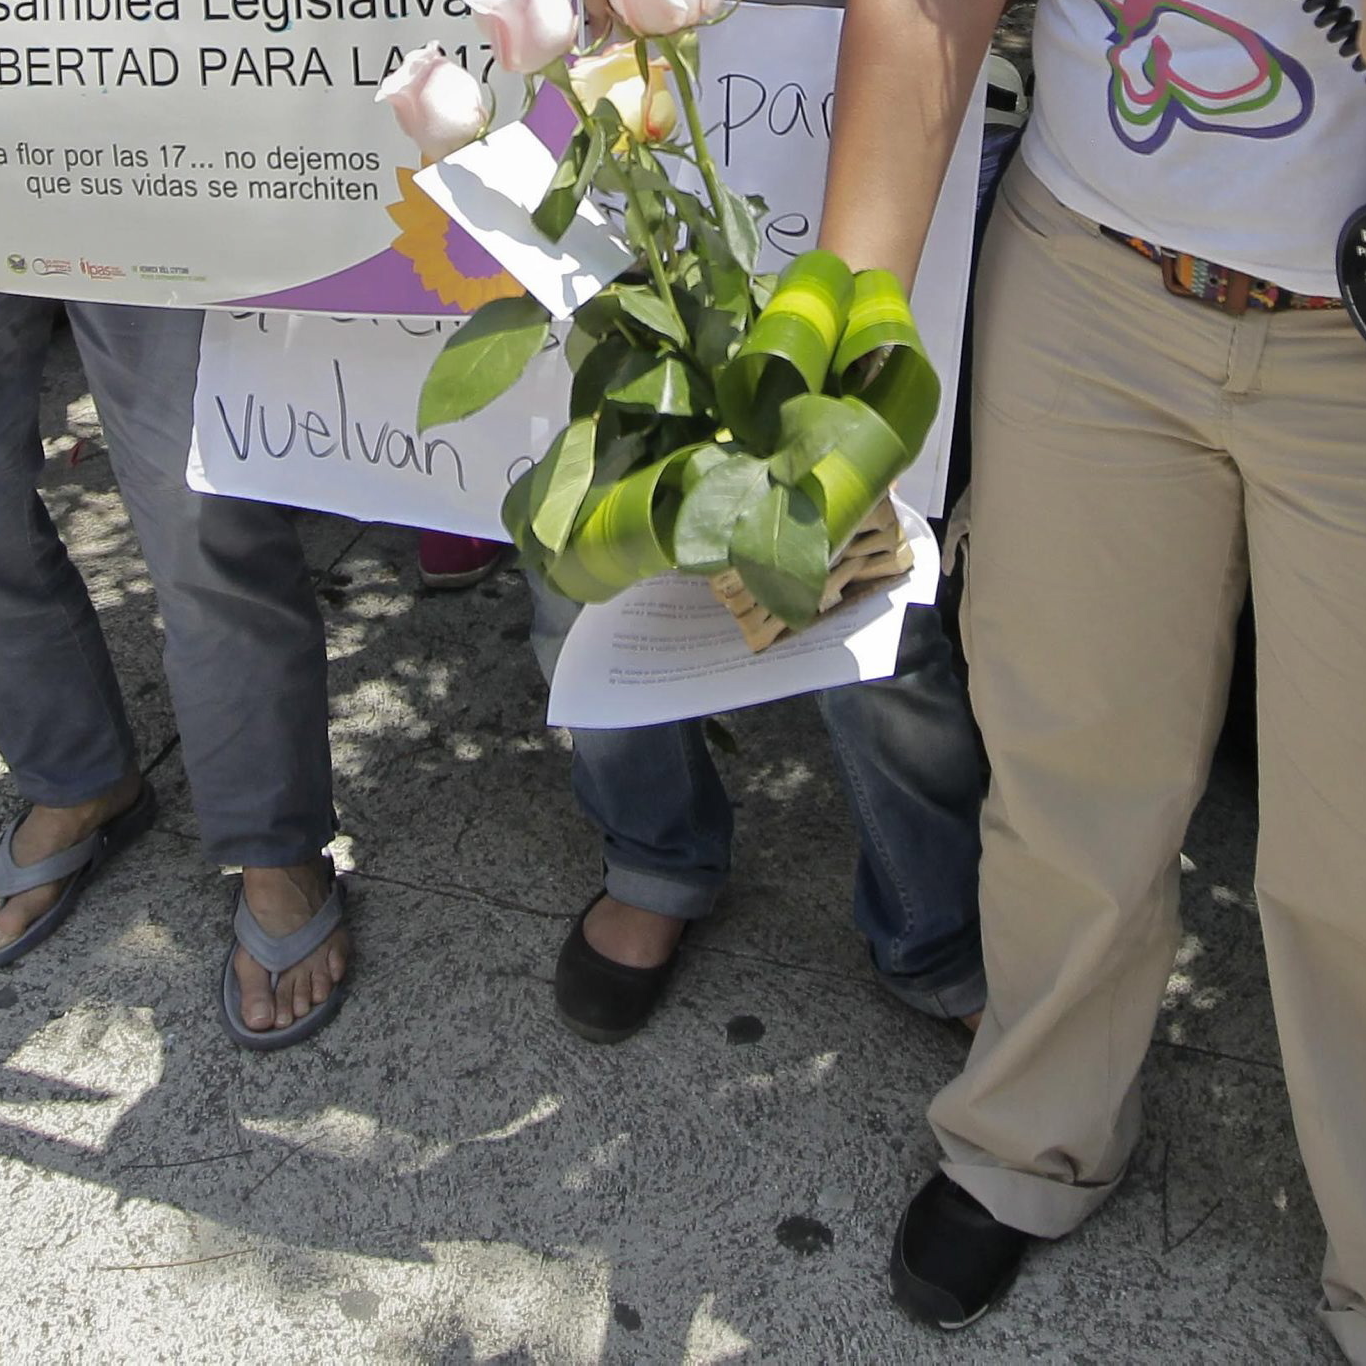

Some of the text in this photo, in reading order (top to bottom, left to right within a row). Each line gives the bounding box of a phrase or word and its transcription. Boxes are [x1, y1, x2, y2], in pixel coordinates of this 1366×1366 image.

[198, 45, 333, 88] PARA
[351, 45, 447, 86] LA
[718, 73, 834, 168] par
[15, 141, 55, 166] flor
[64, 148, 104, 172] por
[112, 143, 149, 168] las
[159, 144, 214, 169] 17...
[224, 151, 256, 170] no
[266, 145, 380, 177] dejemos
[26, 172, 378, 201] que sus vidas se marchiten
